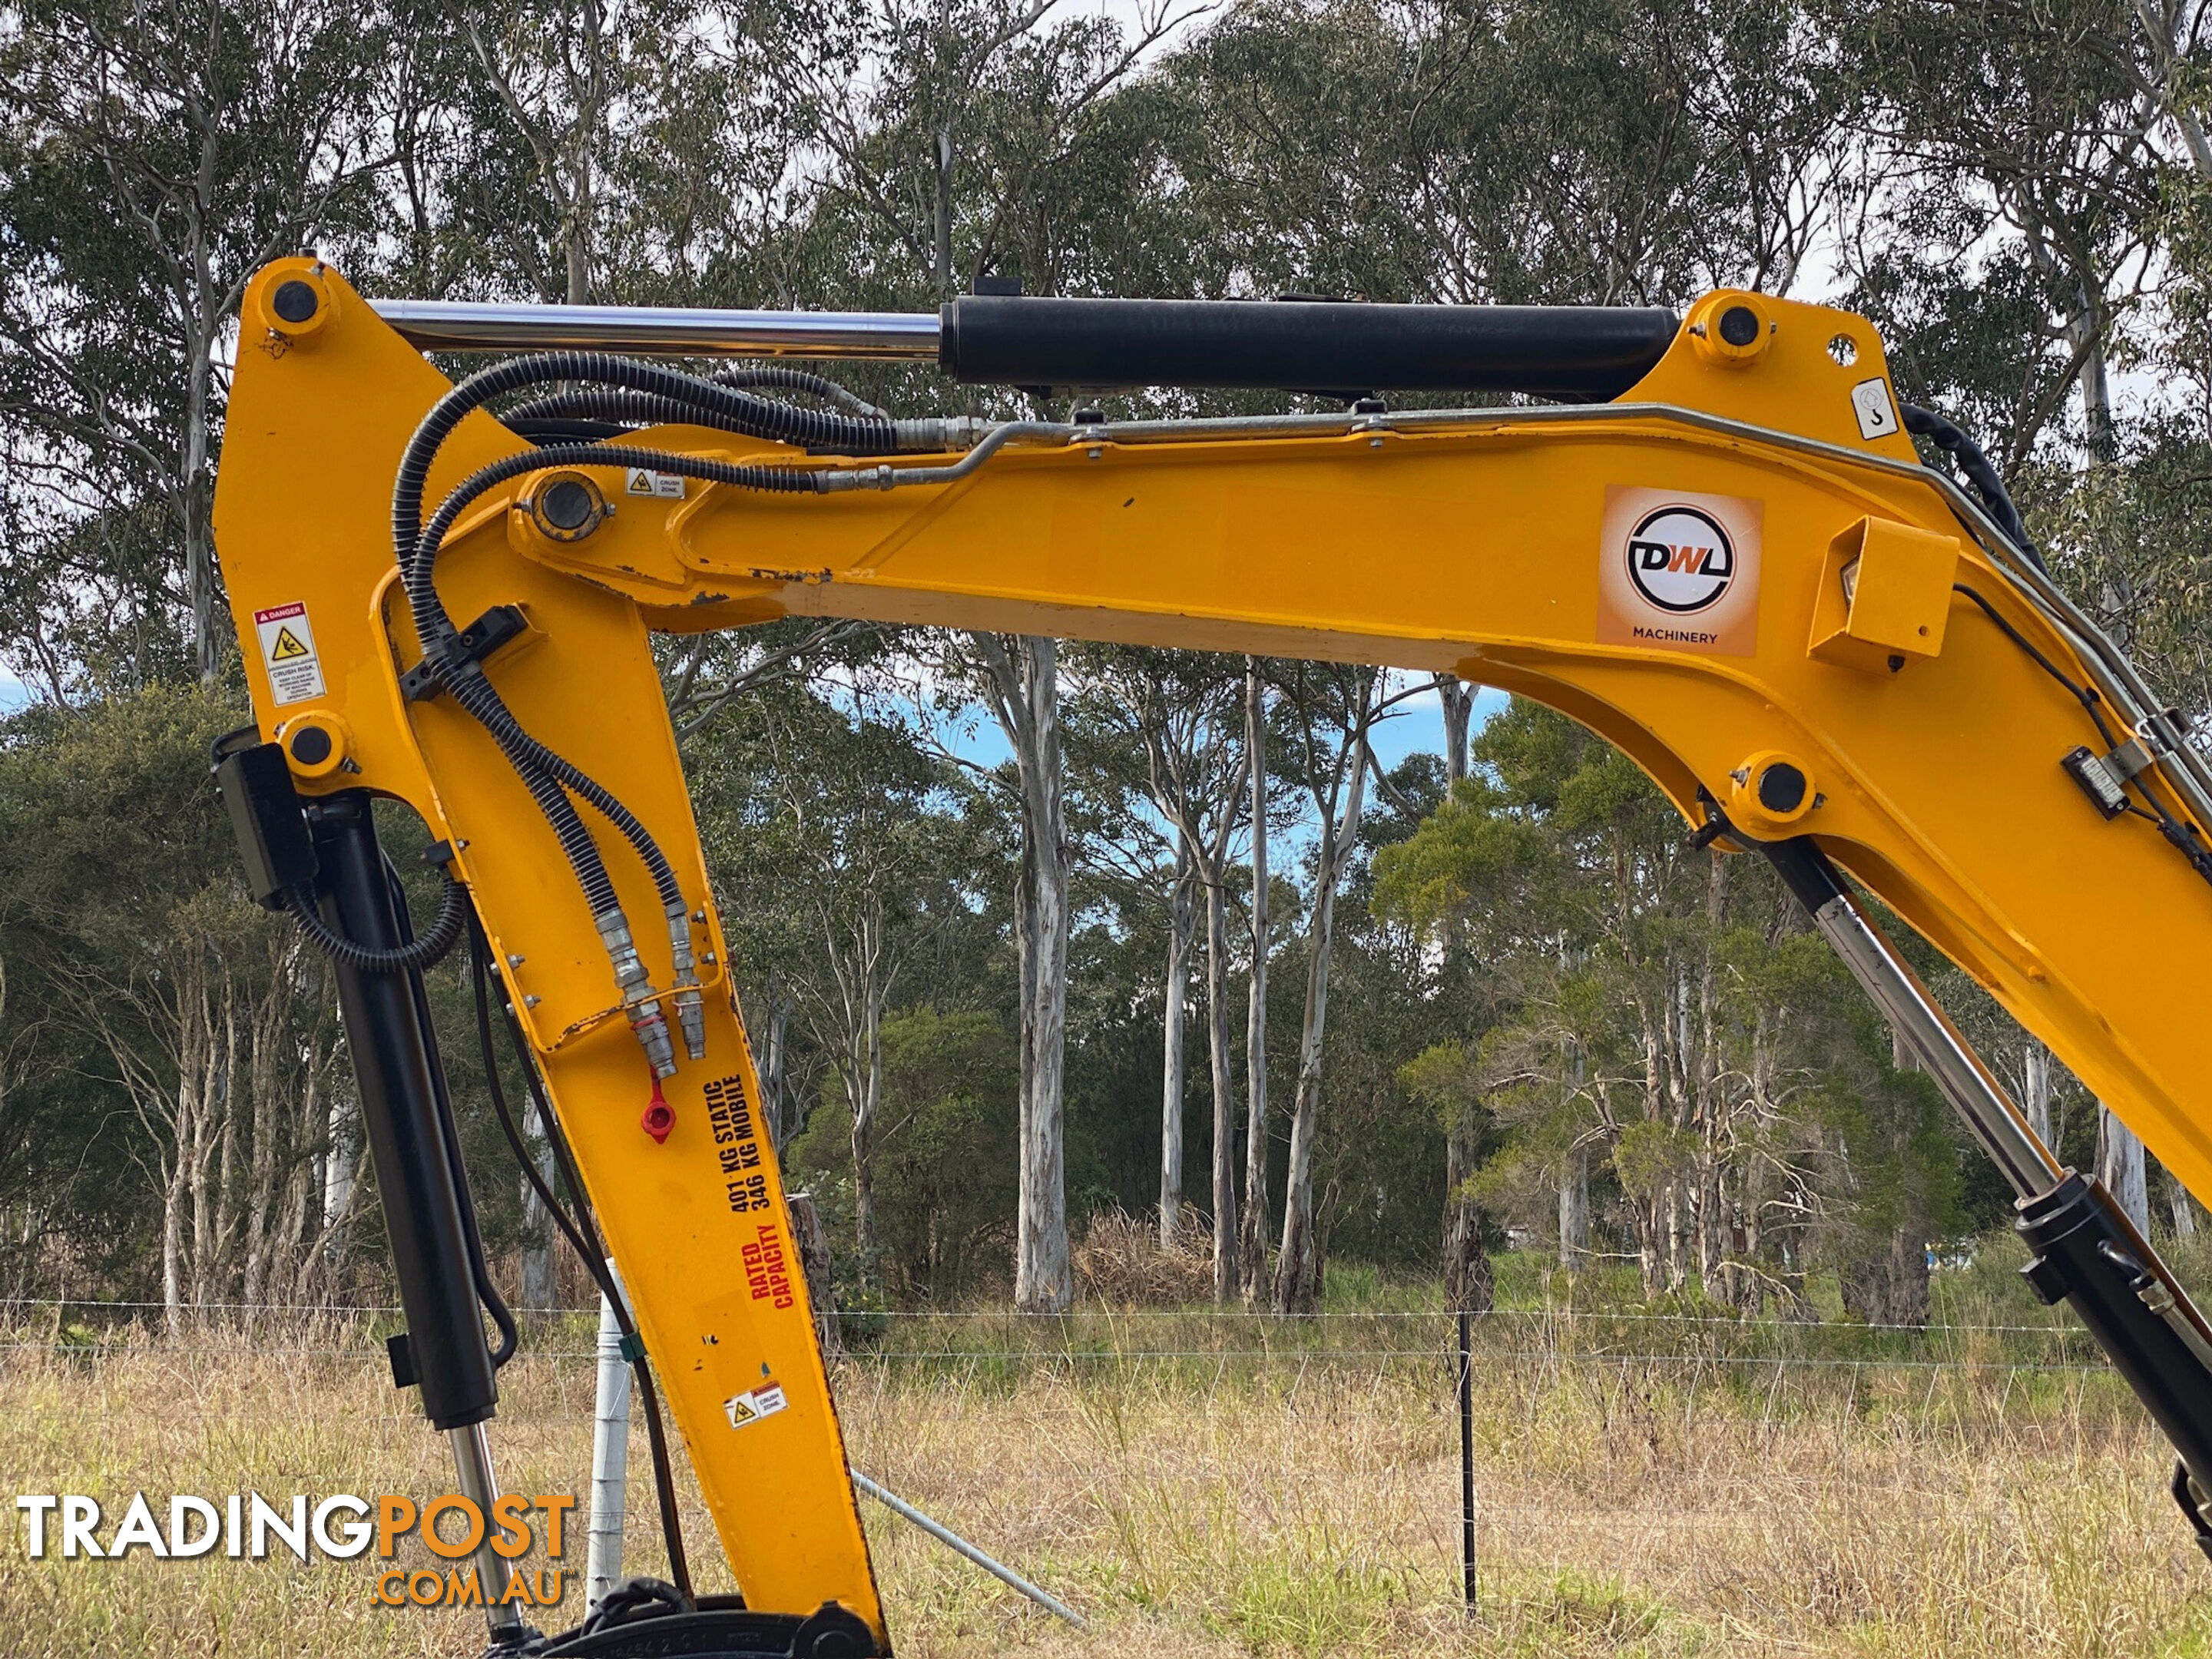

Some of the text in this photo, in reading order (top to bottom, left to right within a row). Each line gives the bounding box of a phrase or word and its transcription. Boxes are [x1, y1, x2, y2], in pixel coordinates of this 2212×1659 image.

[1628, 541, 1731, 578] DWL
[269, 607, 301, 619] DANGER
[1633, 627, 1717, 644] MACHINERY
[273, 669, 296, 678] CRUSH
[704, 1081, 749, 1212] 401 KG STATIC
[723, 1075, 770, 1211] 346 KG MOBILE
[741, 1243, 770, 1300] RATED
[757, 1224, 793, 1310] CAPACITY
